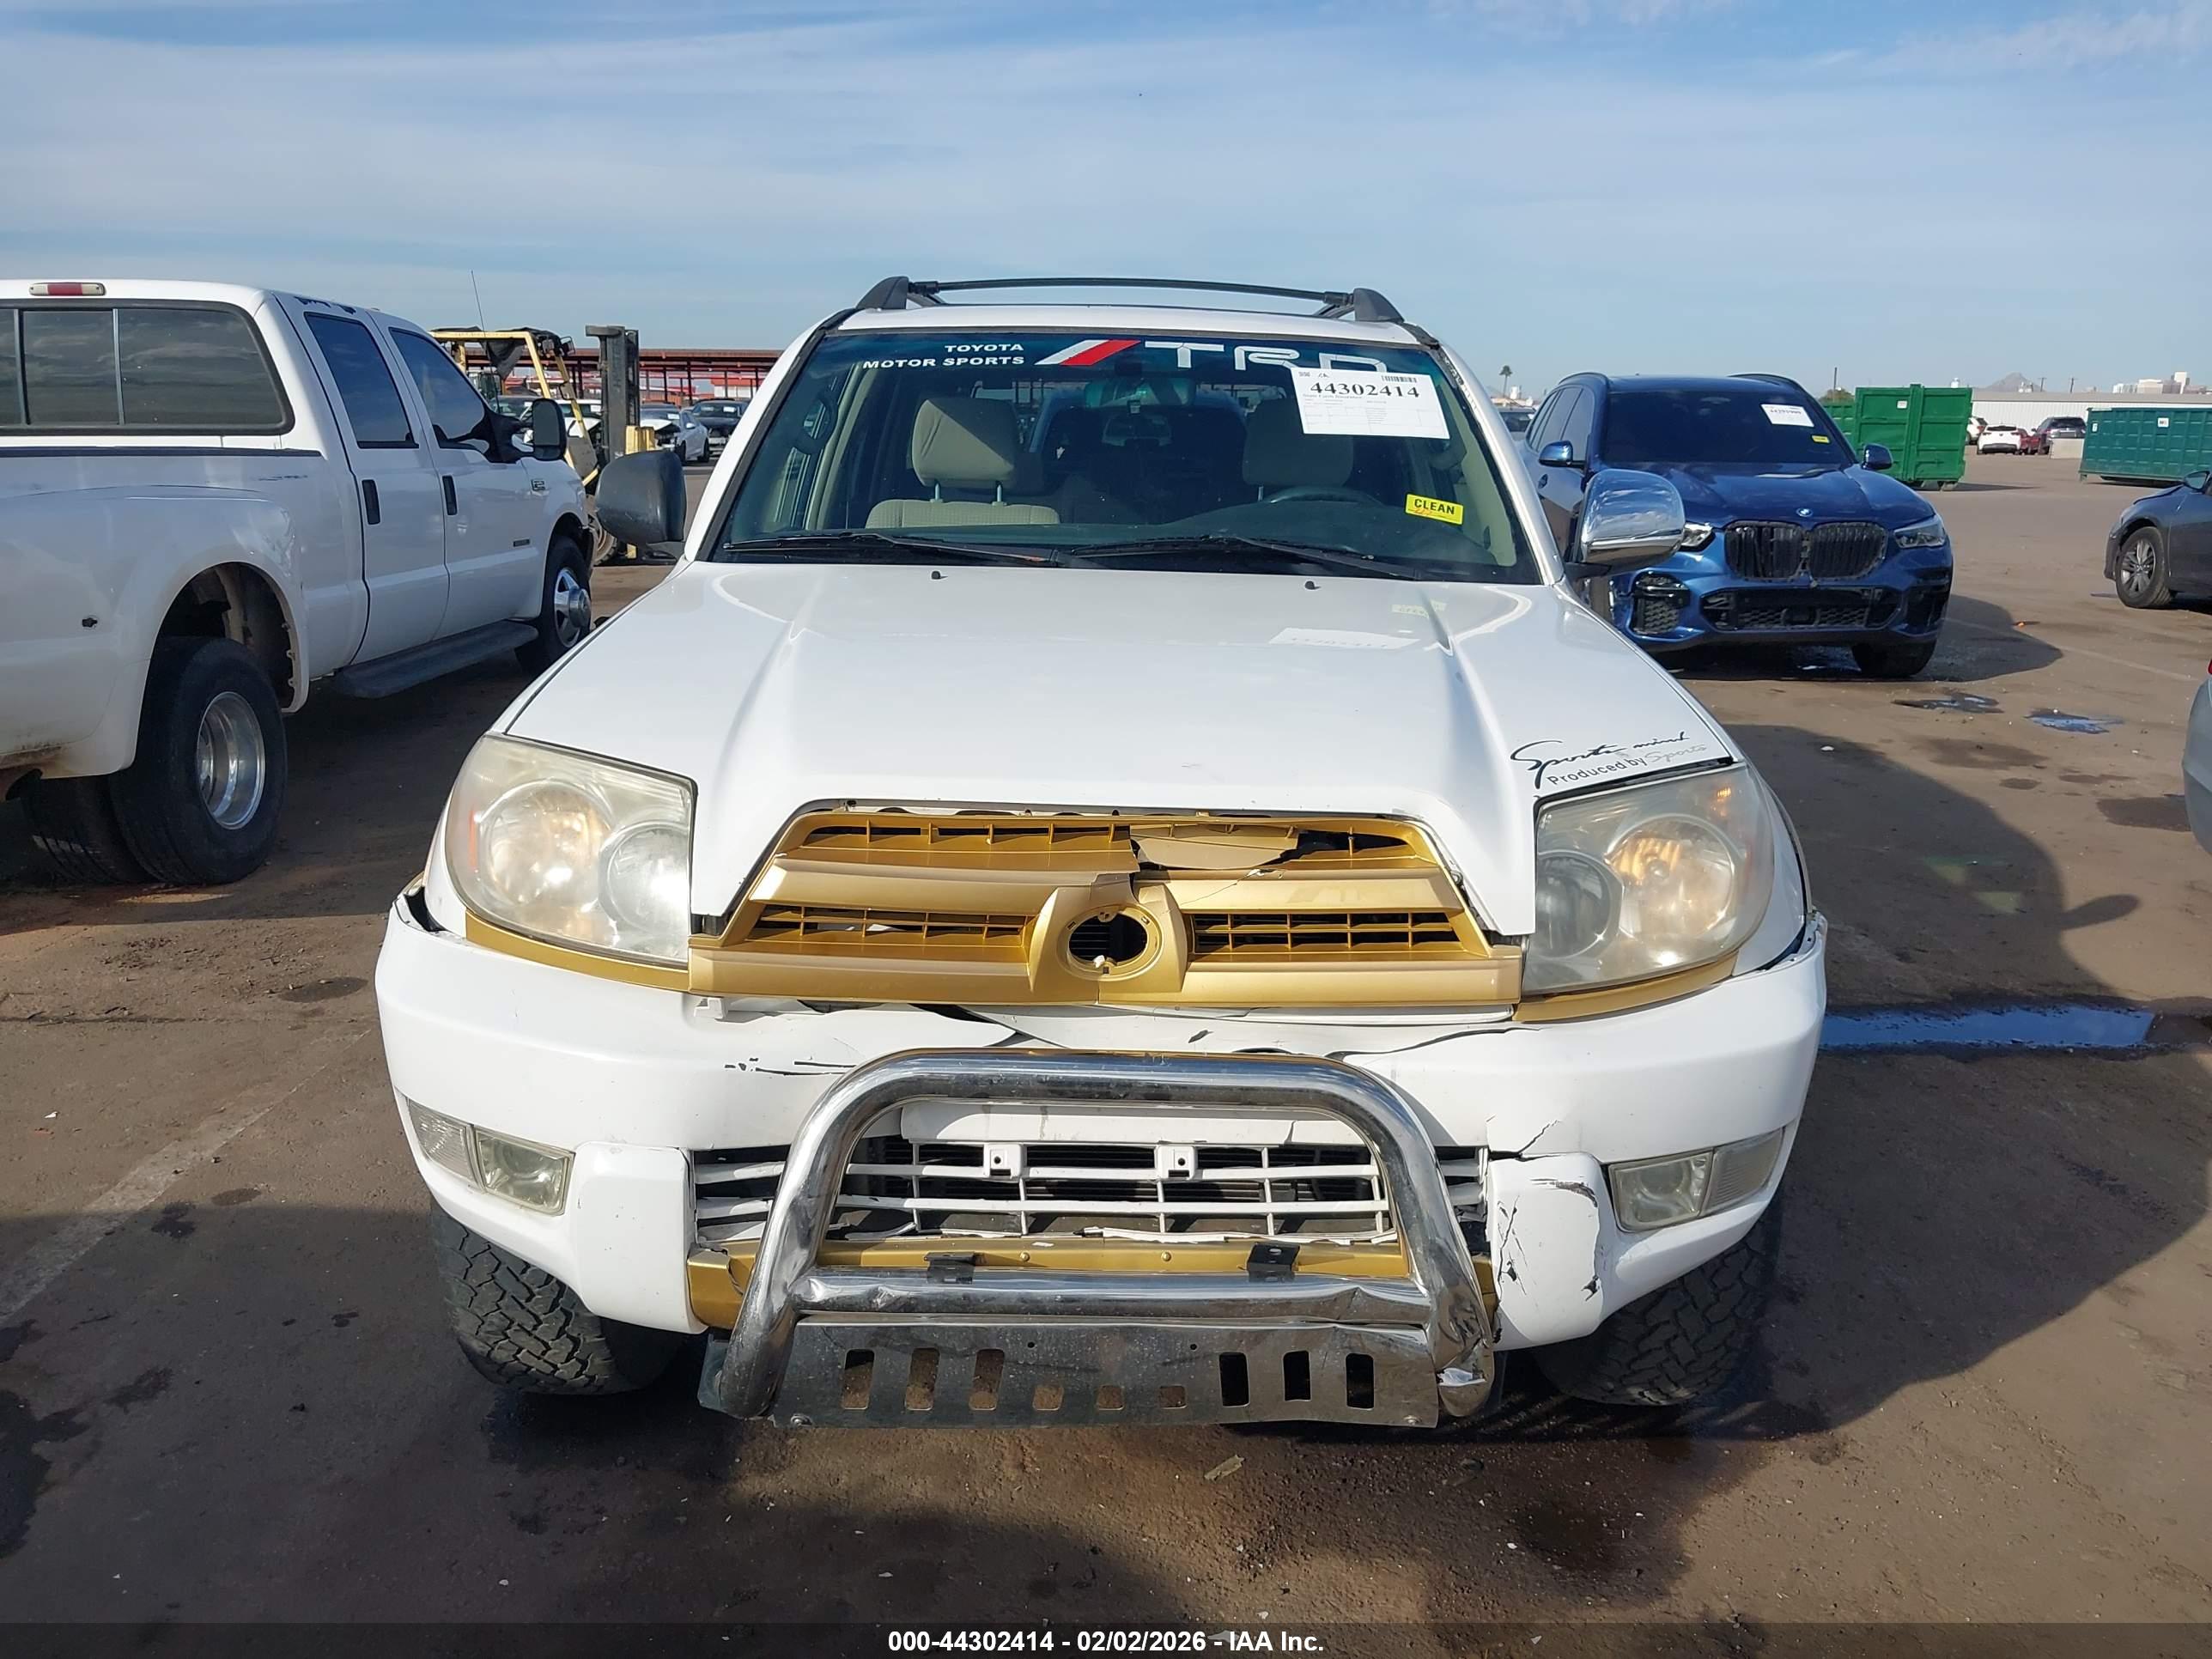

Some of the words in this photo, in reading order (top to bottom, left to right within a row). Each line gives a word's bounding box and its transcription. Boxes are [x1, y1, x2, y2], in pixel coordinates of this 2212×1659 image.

[945, 343, 1024, 353] TOYOTA
[863, 358, 936, 369] MOTOR
[942, 356, 1024, 366] SPORTS
[1145, 341, 1388, 372] TRD
[1310, 382, 1419, 398] 44302414
[1414, 498, 1455, 515] CLEAN
[1547, 761, 1628, 786] Produced
[1623, 757, 1647, 767] by
